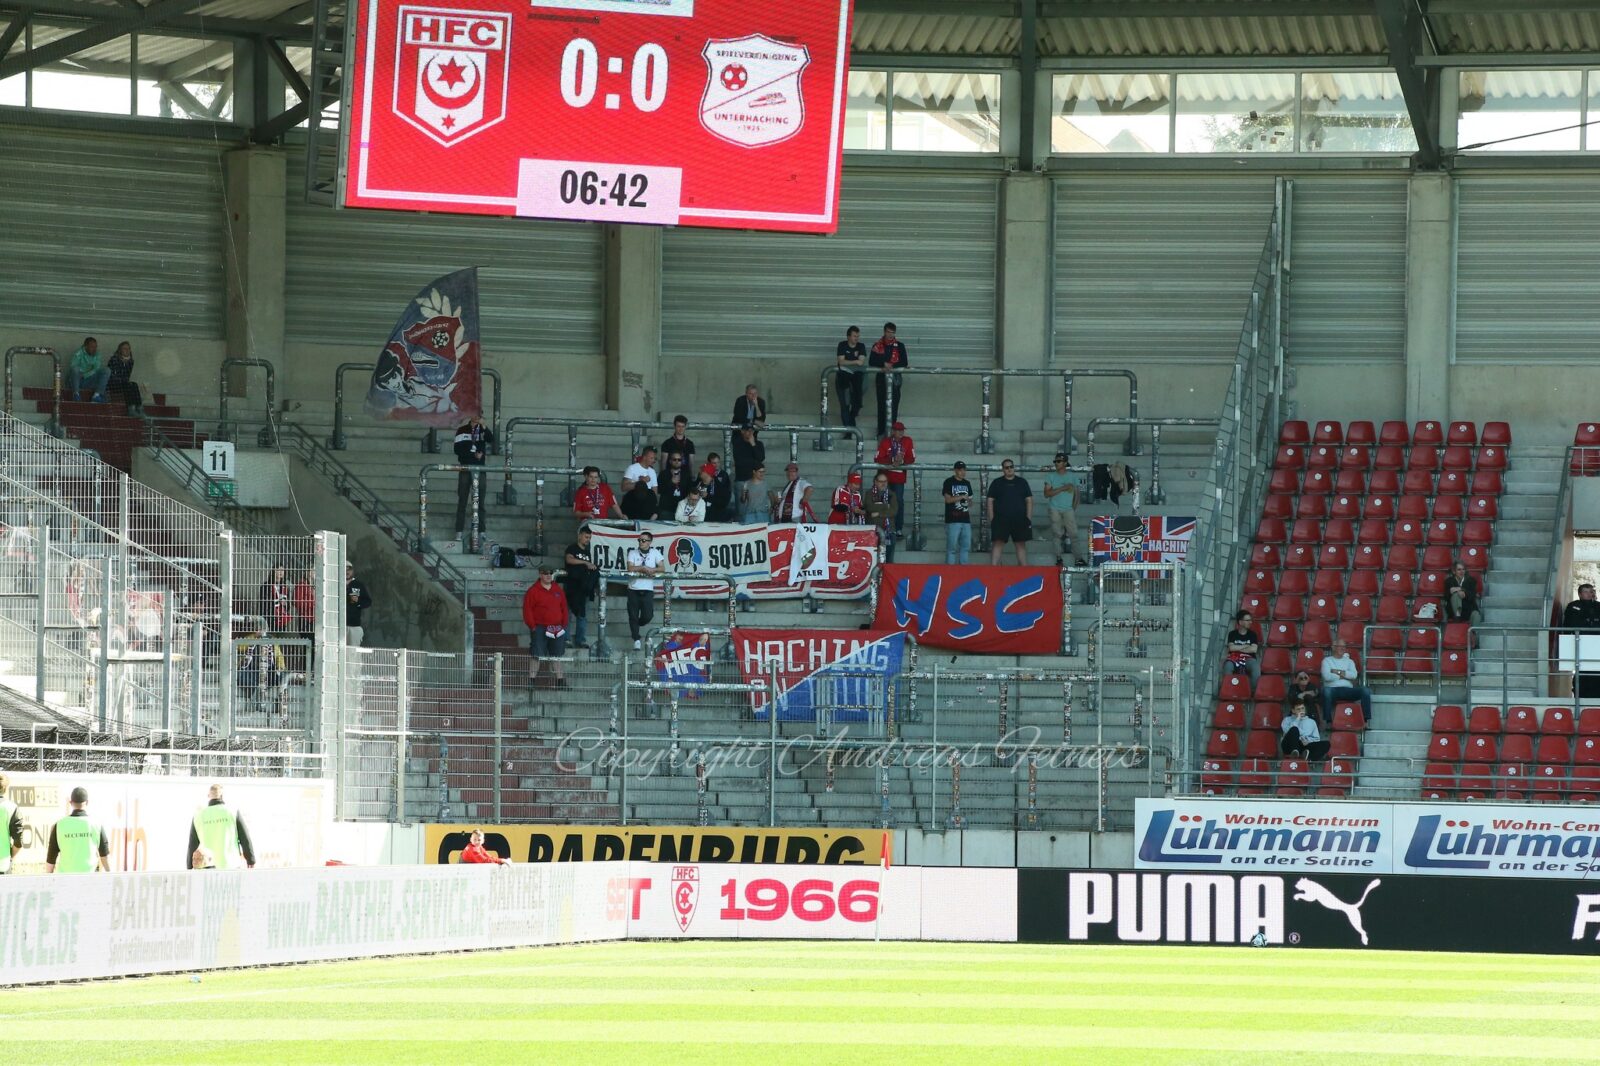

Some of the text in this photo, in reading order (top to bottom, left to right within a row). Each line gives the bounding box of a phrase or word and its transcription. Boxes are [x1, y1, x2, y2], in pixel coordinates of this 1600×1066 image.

[411, 17, 497, 46] HFC
[560, 37, 669, 113] 0:0
[714, 113, 789, 125] UNTERHACHING
[560, 169, 648, 208] 06:42
[209, 450, 227, 471] 11
[708, 539, 767, 570] SQUAD
[1148, 540, 1190, 553] HACHIN
[892, 574, 1044, 640] HSC
[743, 638, 890, 676] HACHING
[1138, 809, 1381, 864] Lührmann
[1225, 814, 1379, 827] Wohn-Centrum
[676, 868, 695, 880] HFC
[1231, 855, 1374, 867] an der Saline
[1499, 862, 1525, 870] an
[1532, 861, 1569, 871] der
[109, 874, 196, 931] BARTHEL
[720, 878, 880, 923] 1966
[1068, 872, 1285, 944] PUMA
[1571, 893, 1600, 941] F
